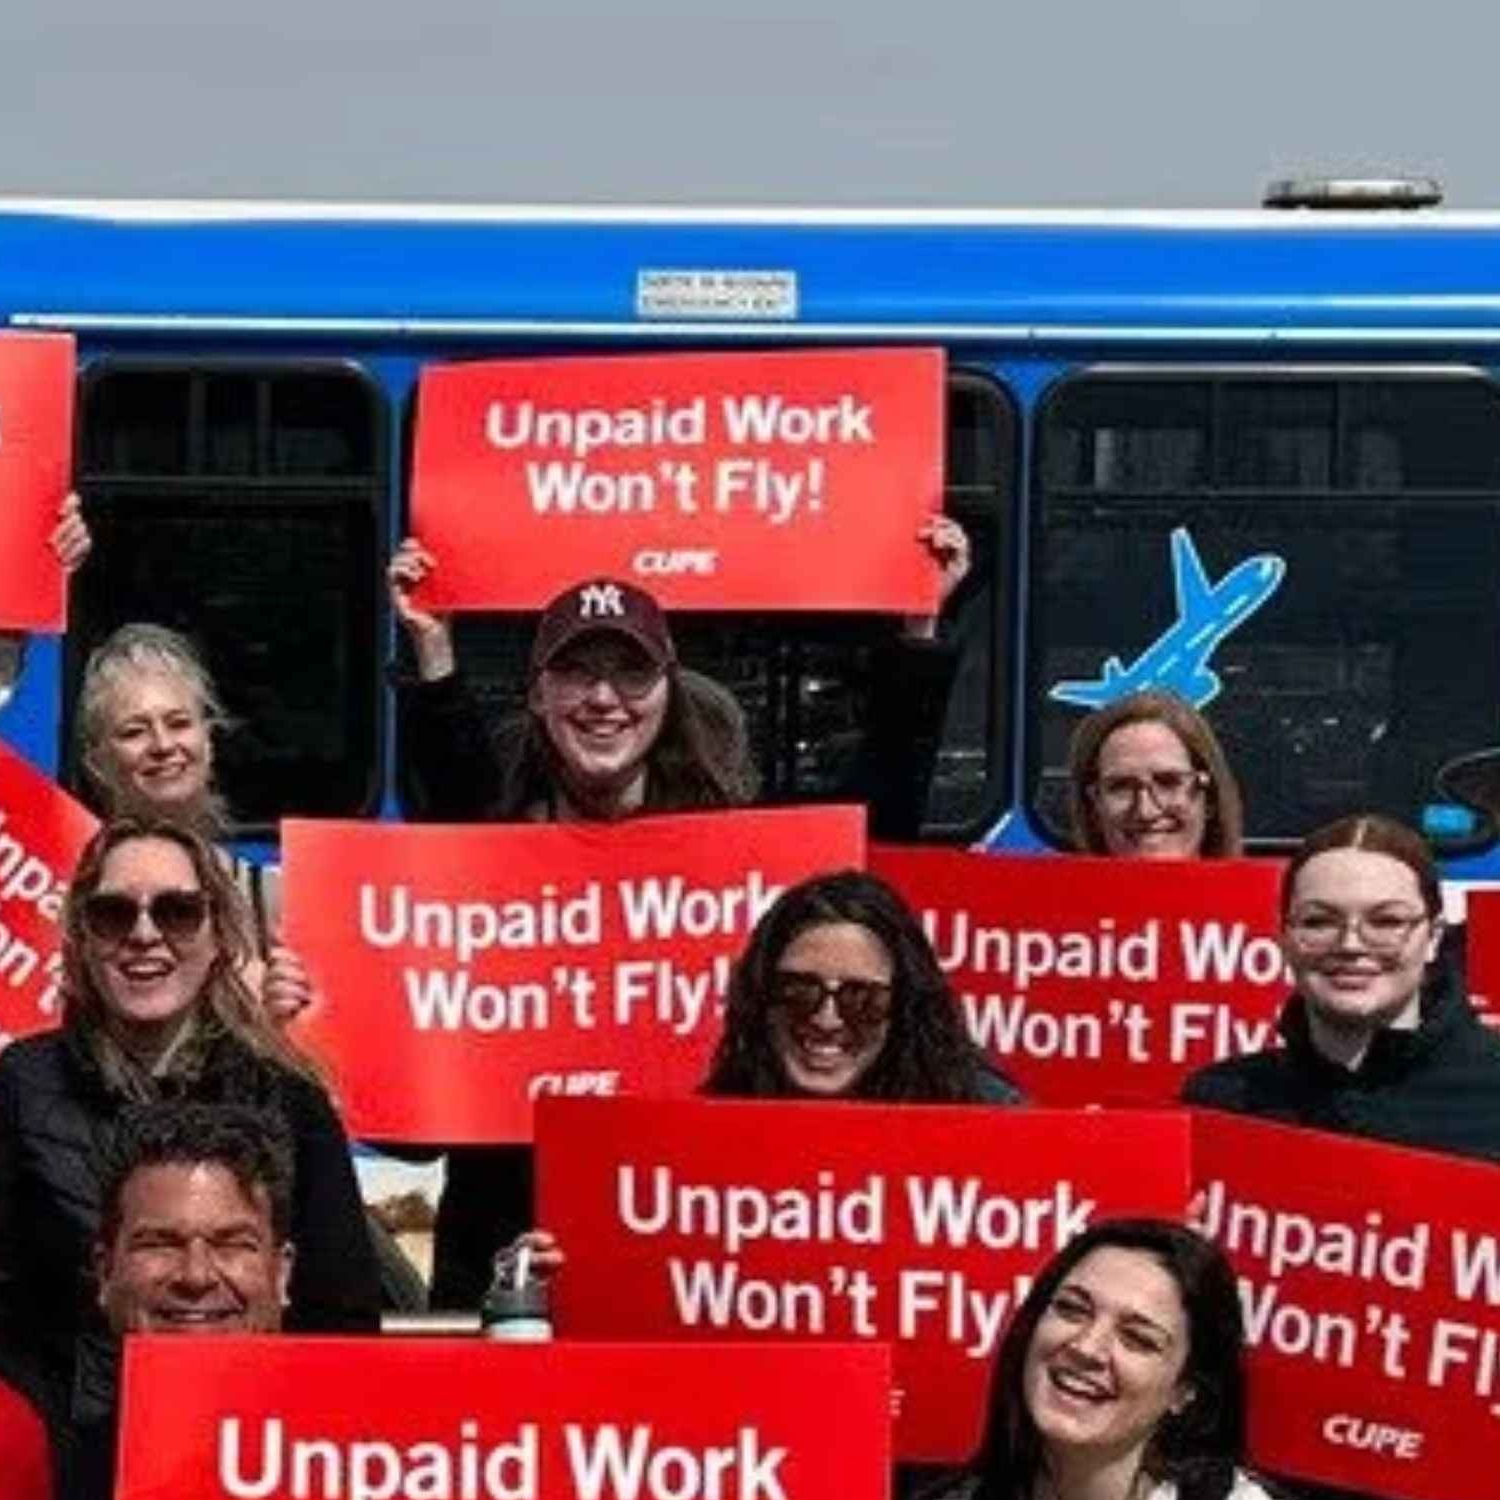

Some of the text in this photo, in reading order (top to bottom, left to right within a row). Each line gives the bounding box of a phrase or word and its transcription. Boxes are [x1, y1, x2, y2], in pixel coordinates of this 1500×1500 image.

[486, 396, 873, 457] Unpaid Work
[528, 458, 825, 525] Won't Fly!
[632, 550, 720, 575] CUPE
[360, 880, 601, 965] Unpaid
[923, 908, 1297, 990] Unpaid Wo
[405, 955, 730, 1035] Won't Fly!
[961, 993, 1151, 1062] Won't
[618, 1165, 1097, 1253] Unpaid Work
[671, 1260, 877, 1339] Won't
[1427, 1318, 1500, 1419] Fl
[1322, 1413, 1425, 1459] CUPE
